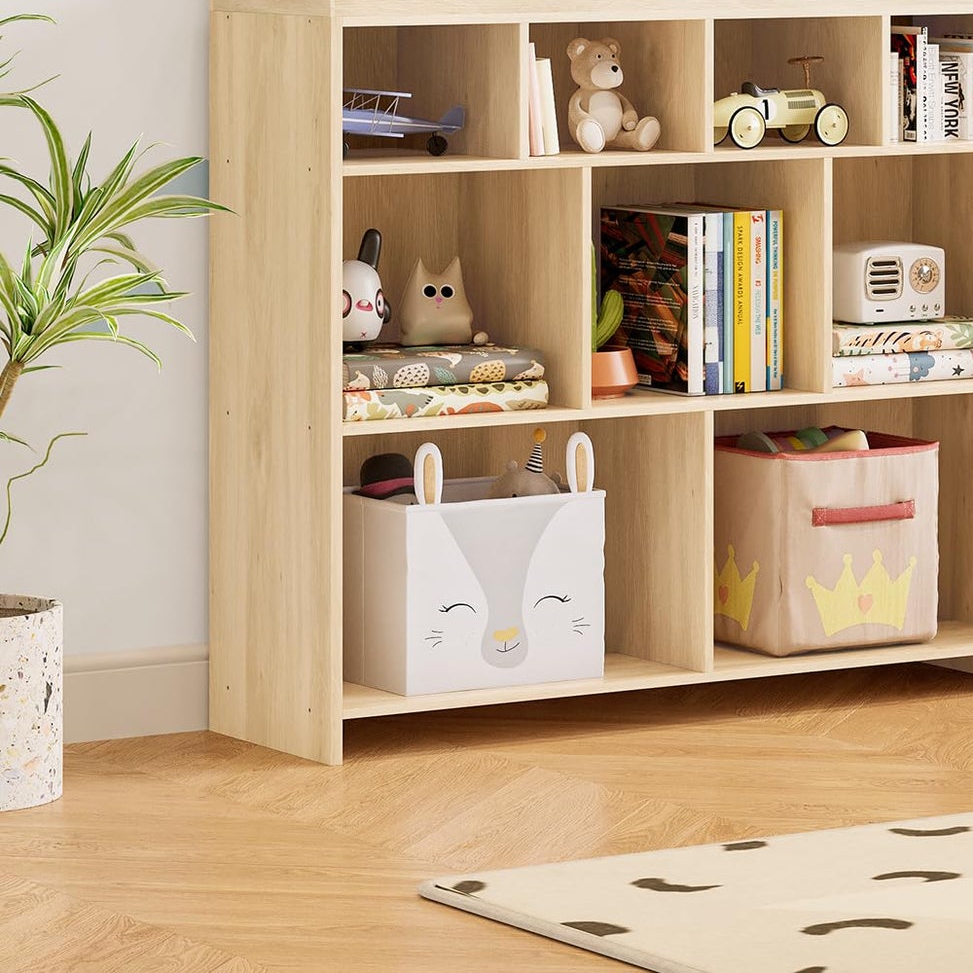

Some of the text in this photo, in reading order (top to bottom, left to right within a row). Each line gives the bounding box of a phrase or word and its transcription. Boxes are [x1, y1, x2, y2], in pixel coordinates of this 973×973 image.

[762, 99, 770, 121] 1
[944, 98, 959, 138] YORK
[754, 236, 762, 265] SMASHING
